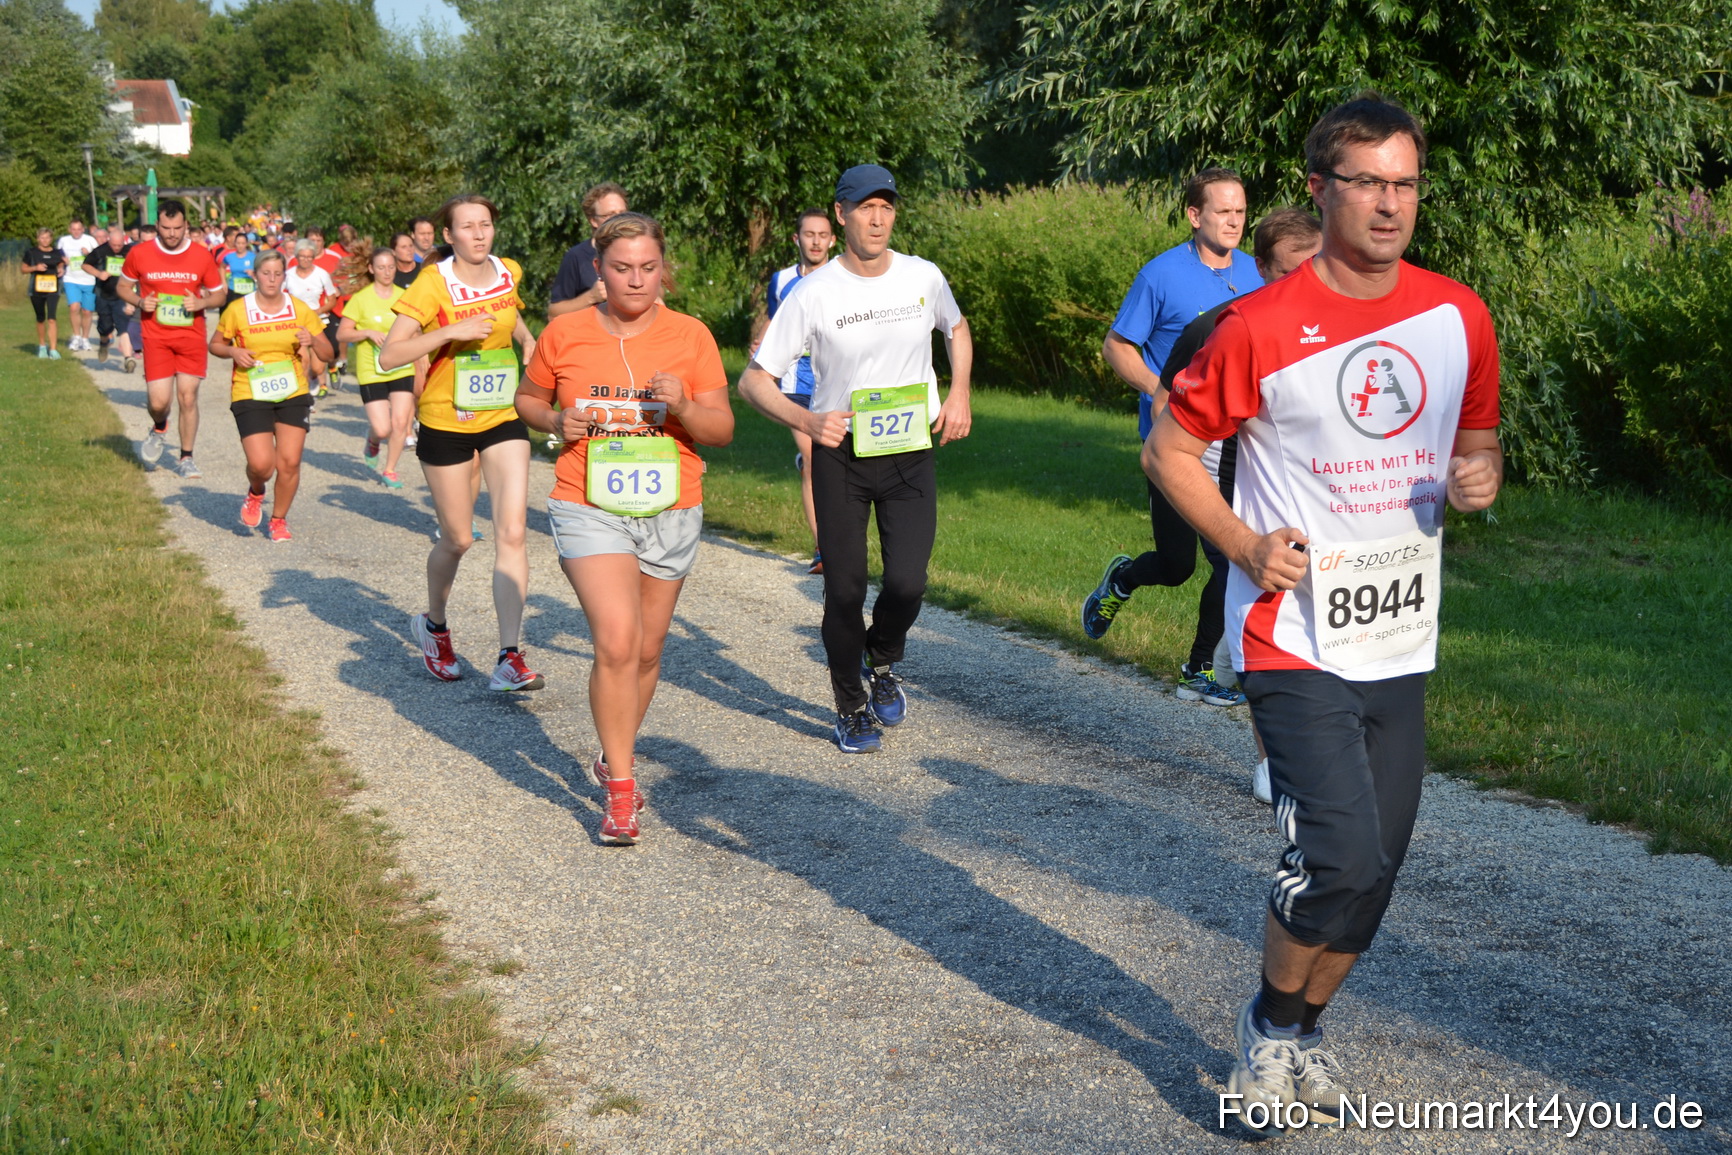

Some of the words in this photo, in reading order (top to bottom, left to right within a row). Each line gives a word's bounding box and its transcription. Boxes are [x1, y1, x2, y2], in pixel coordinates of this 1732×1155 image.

[147, 272, 190, 280] NEUMARKT
[454, 305, 487, 320] MAX
[836, 303, 922, 329] globalconcepts
[249, 326, 272, 334] MAX
[1300, 335, 1327, 344] erima
[260, 377, 289, 393] 869
[469, 374, 507, 394] 887
[590, 386, 610, 397] 30
[614, 386, 652, 399] Jahre
[586, 407, 660, 425] OBI
[870, 411, 914, 437] 527
[607, 469, 662, 495] 613
[1328, 484, 1346, 494] Dr.
[1349, 481, 1379, 493] Heck
[1389, 478, 1404, 489] Dr.
[1329, 492, 1437, 514] Leistungsdiagnostik
[1318, 543, 1421, 571] df-sports
[1327, 573, 1425, 629] 8944
[1322, 619, 1432, 650] www.df-sports.de
